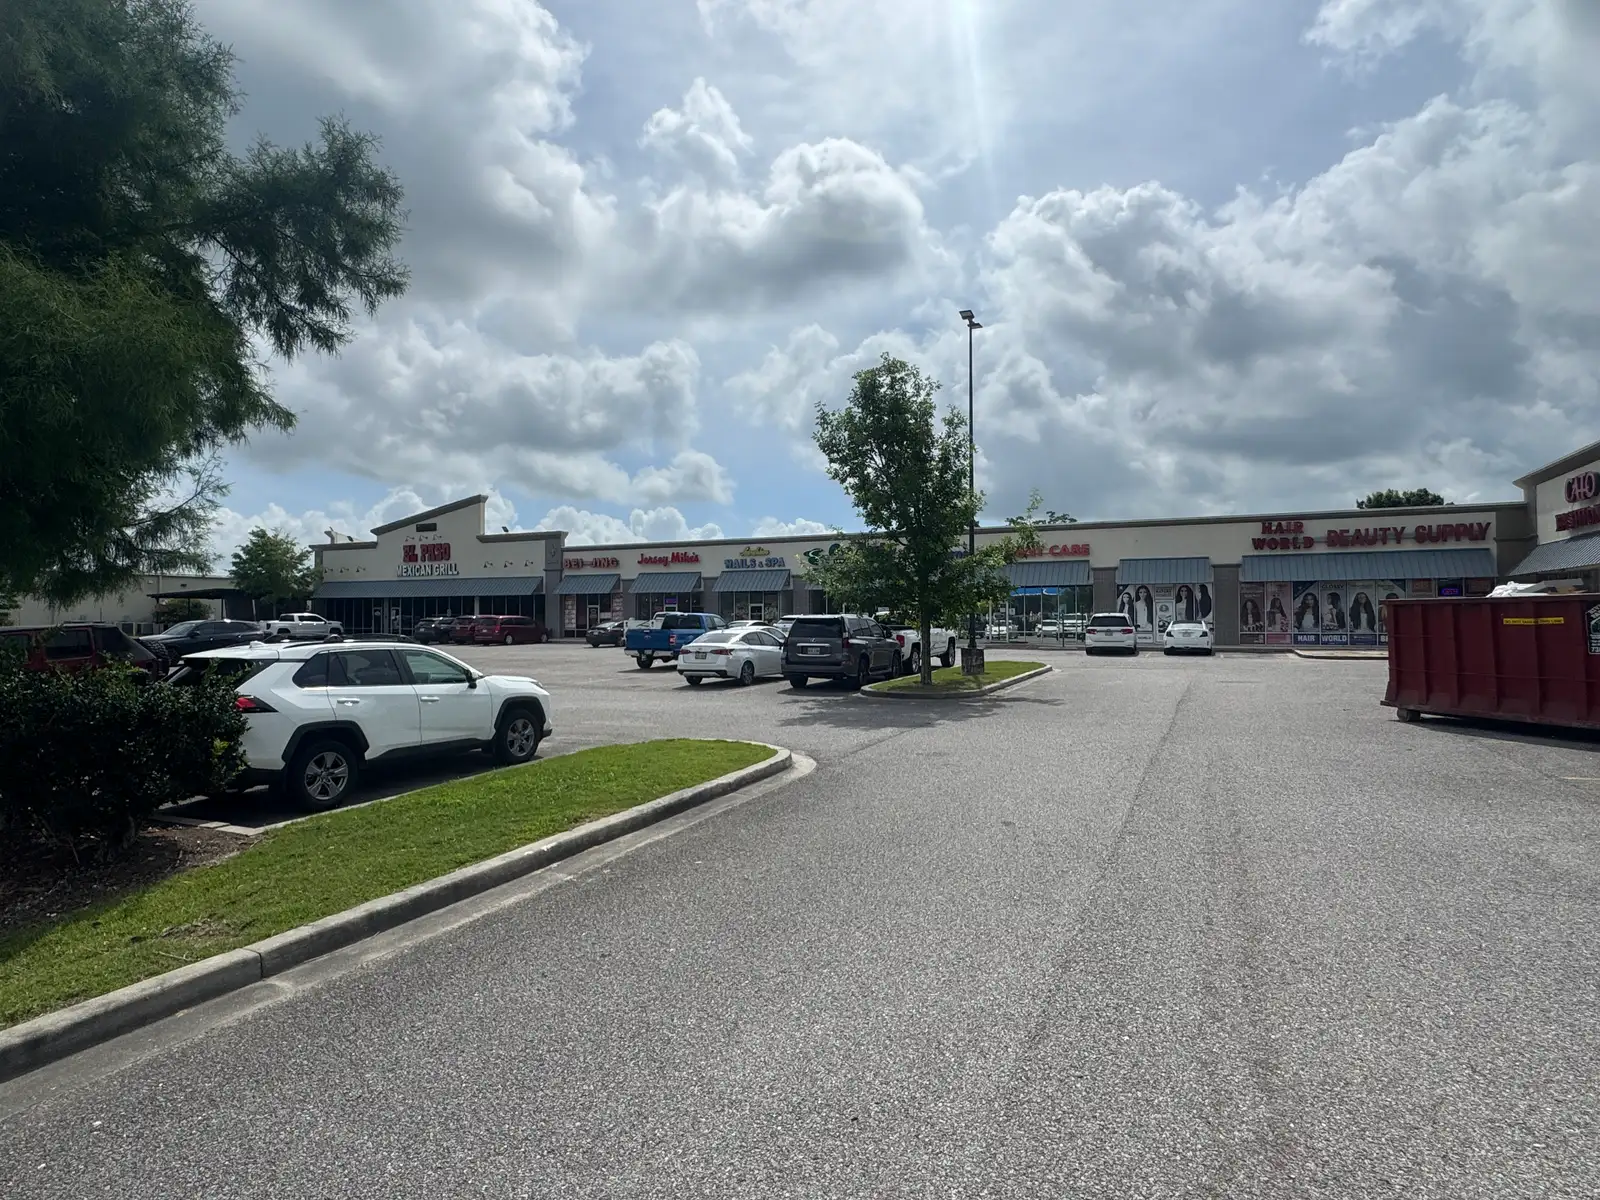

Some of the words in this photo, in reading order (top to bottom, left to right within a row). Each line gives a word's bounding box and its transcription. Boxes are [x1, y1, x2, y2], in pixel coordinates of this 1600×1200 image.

[1261, 521, 1305, 534] HAIR
[1326, 526, 1406, 547] BEAUTY
[1414, 522, 1491, 544] SUPPLY
[1049, 543, 1090, 557] CARE
[1252, 536, 1315, 550] WORLD
[403, 544, 418, 562] EL
[420, 543, 451, 562] PASO
[397, 564, 432, 577] MEXICAN
[433, 563, 459, 576] GRILL
[724, 558, 756, 569] NAILS
[765, 557, 785, 568] SPA
[1321, 634, 1347, 642] WORLD
